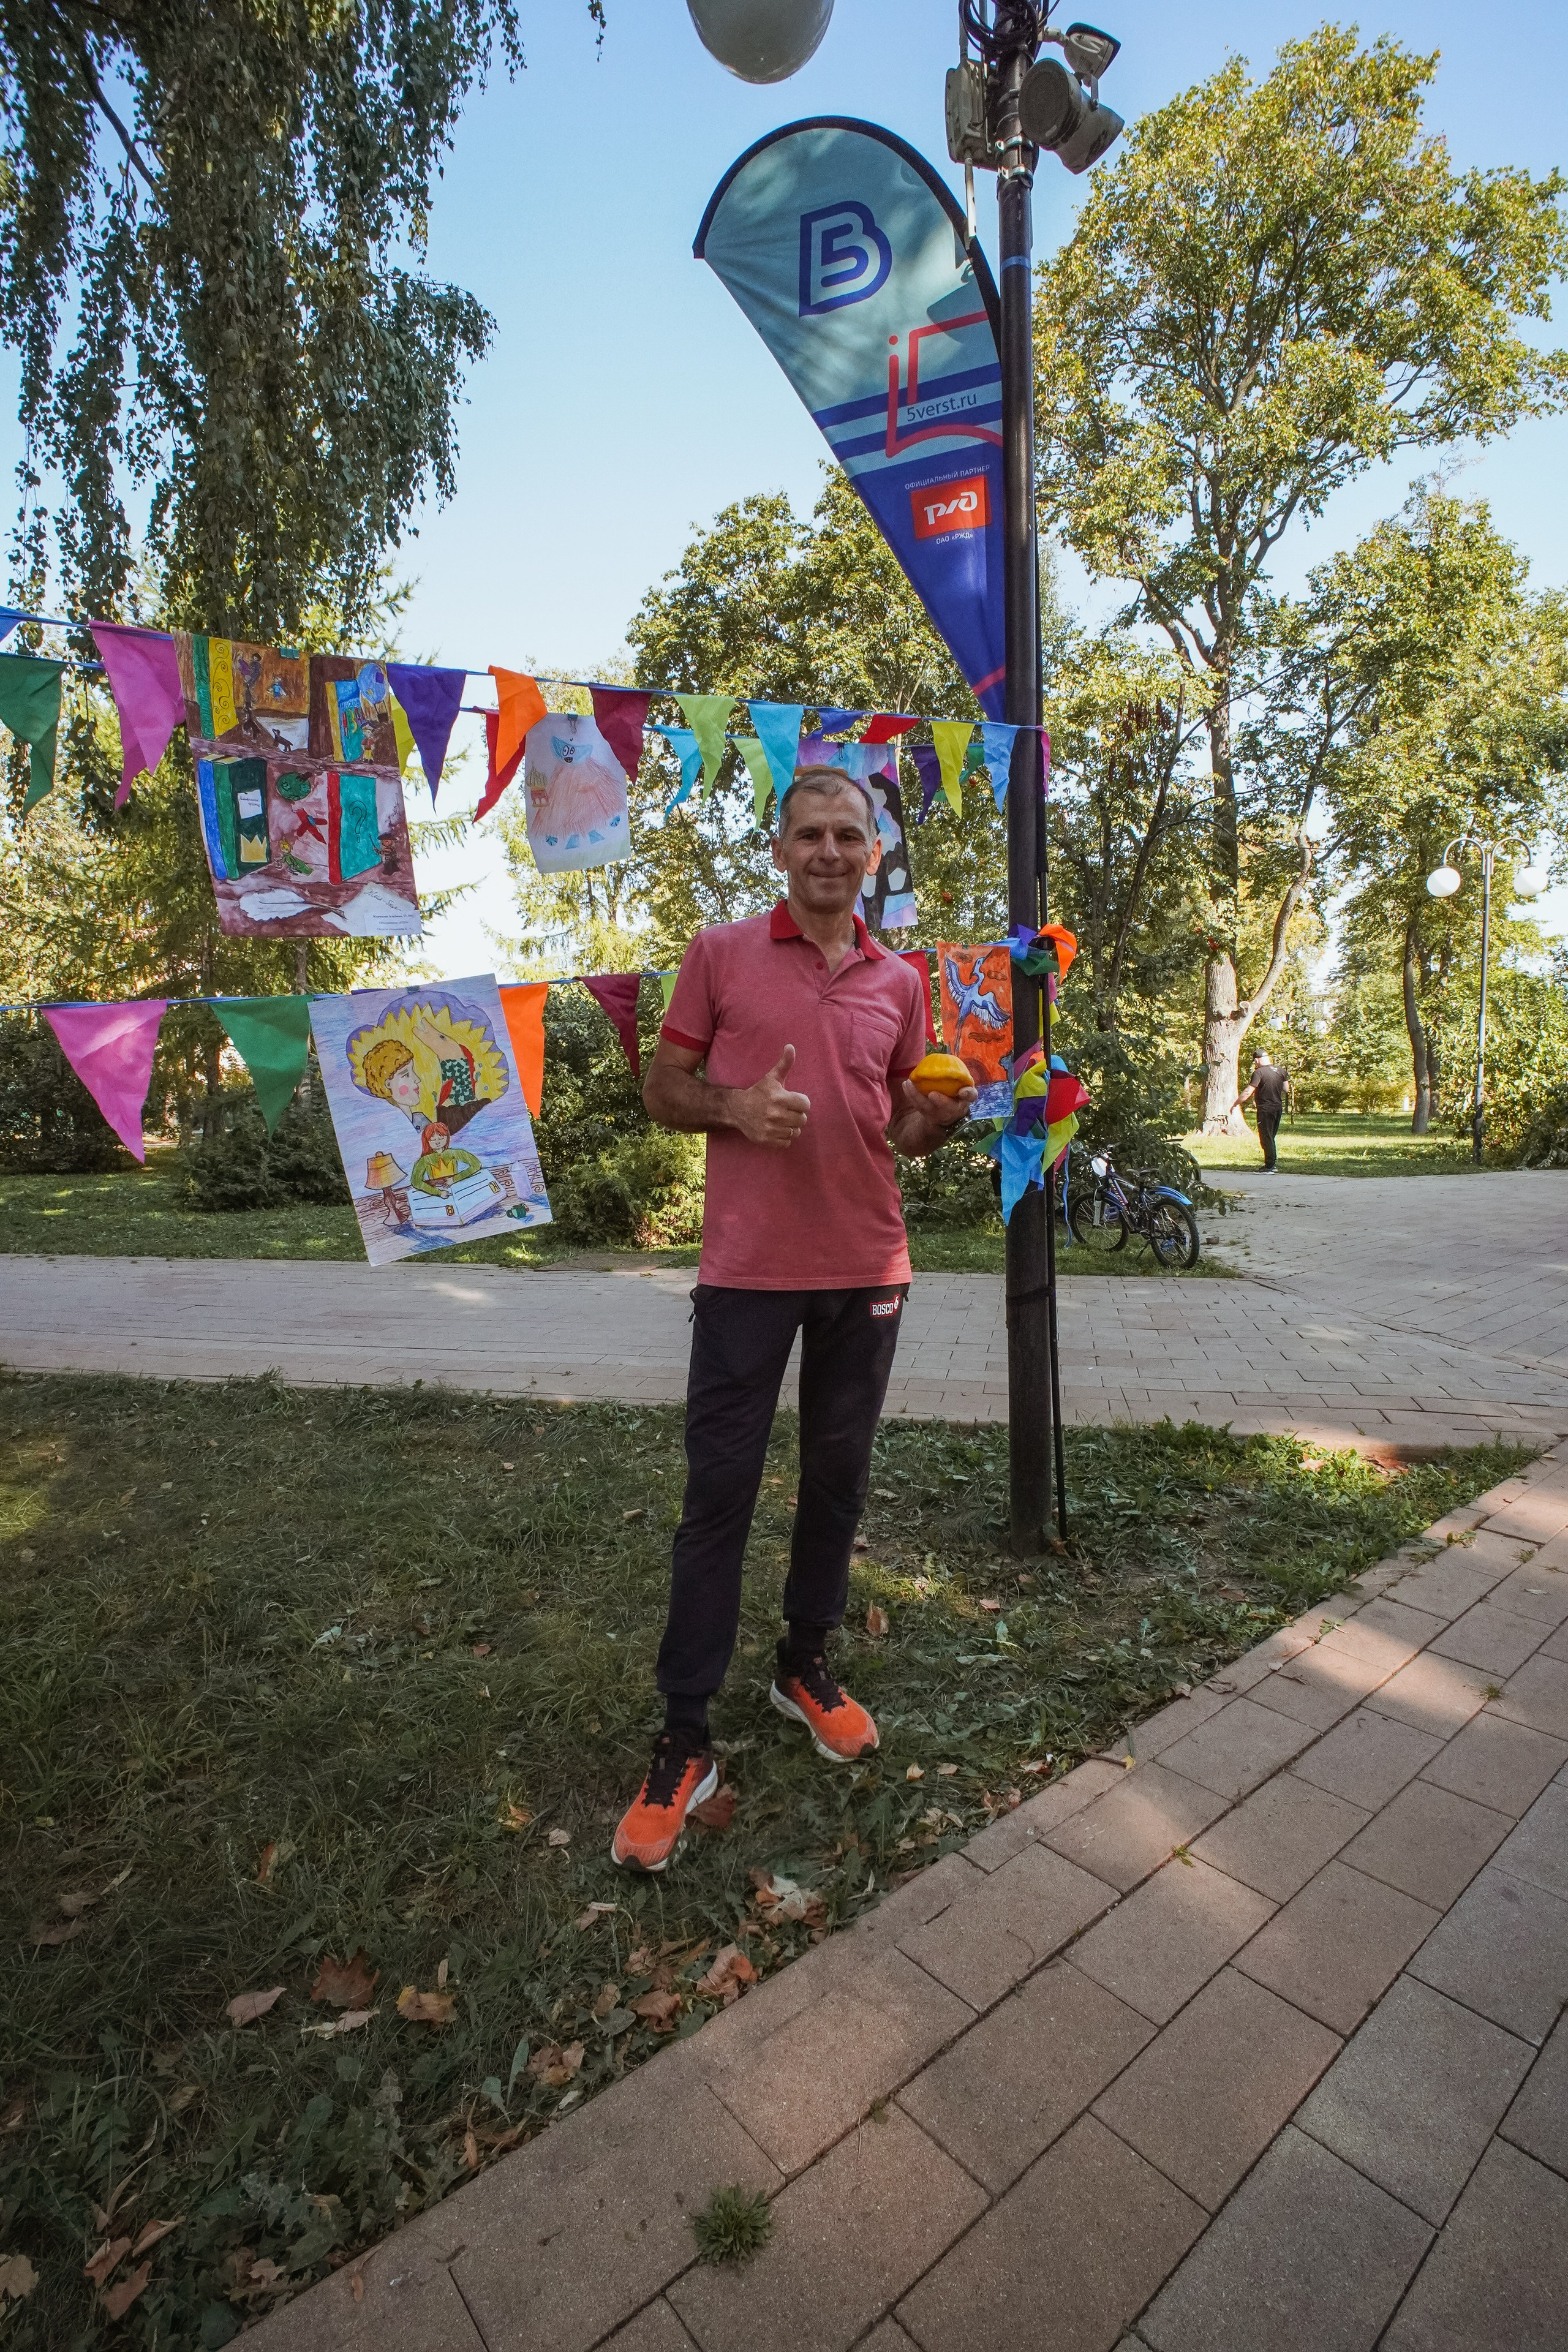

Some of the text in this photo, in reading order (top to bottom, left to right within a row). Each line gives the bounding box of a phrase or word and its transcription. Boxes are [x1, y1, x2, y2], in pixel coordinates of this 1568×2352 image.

[907, 393, 978, 422] 5verst.ru
[905, 464, 990, 490] ОФИЦИАЛЬНЫЙ ПАРТНЕР
[936, 535, 950, 545] ОАО
[872, 1302, 894, 1316] BOSCO
